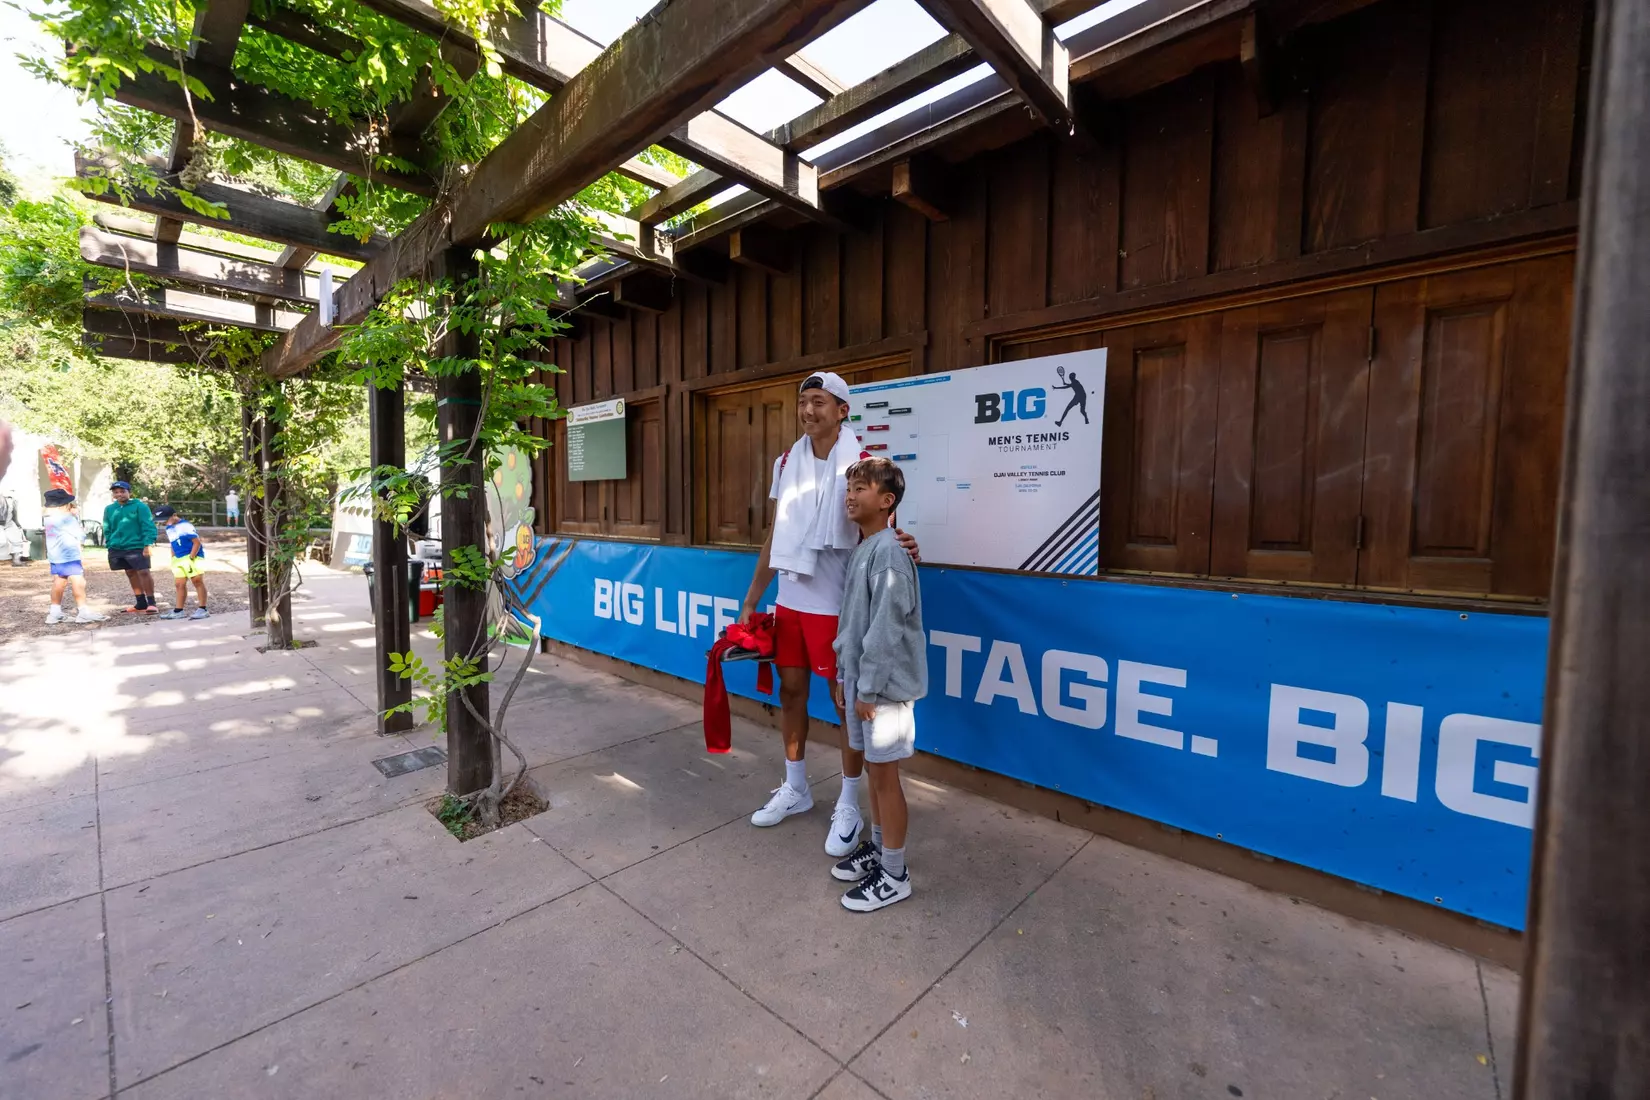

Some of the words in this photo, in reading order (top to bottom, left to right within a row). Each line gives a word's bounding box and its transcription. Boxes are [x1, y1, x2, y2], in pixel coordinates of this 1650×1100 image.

[988, 435, 1022, 446] MEN'S
[1026, 431, 1070, 443] TENNIS
[998, 442, 1058, 453] TOURNAMENT
[594, 577, 644, 626] BIG
[929, 629, 1218, 758] TAGE.
[1266, 683, 1543, 830] BIG
